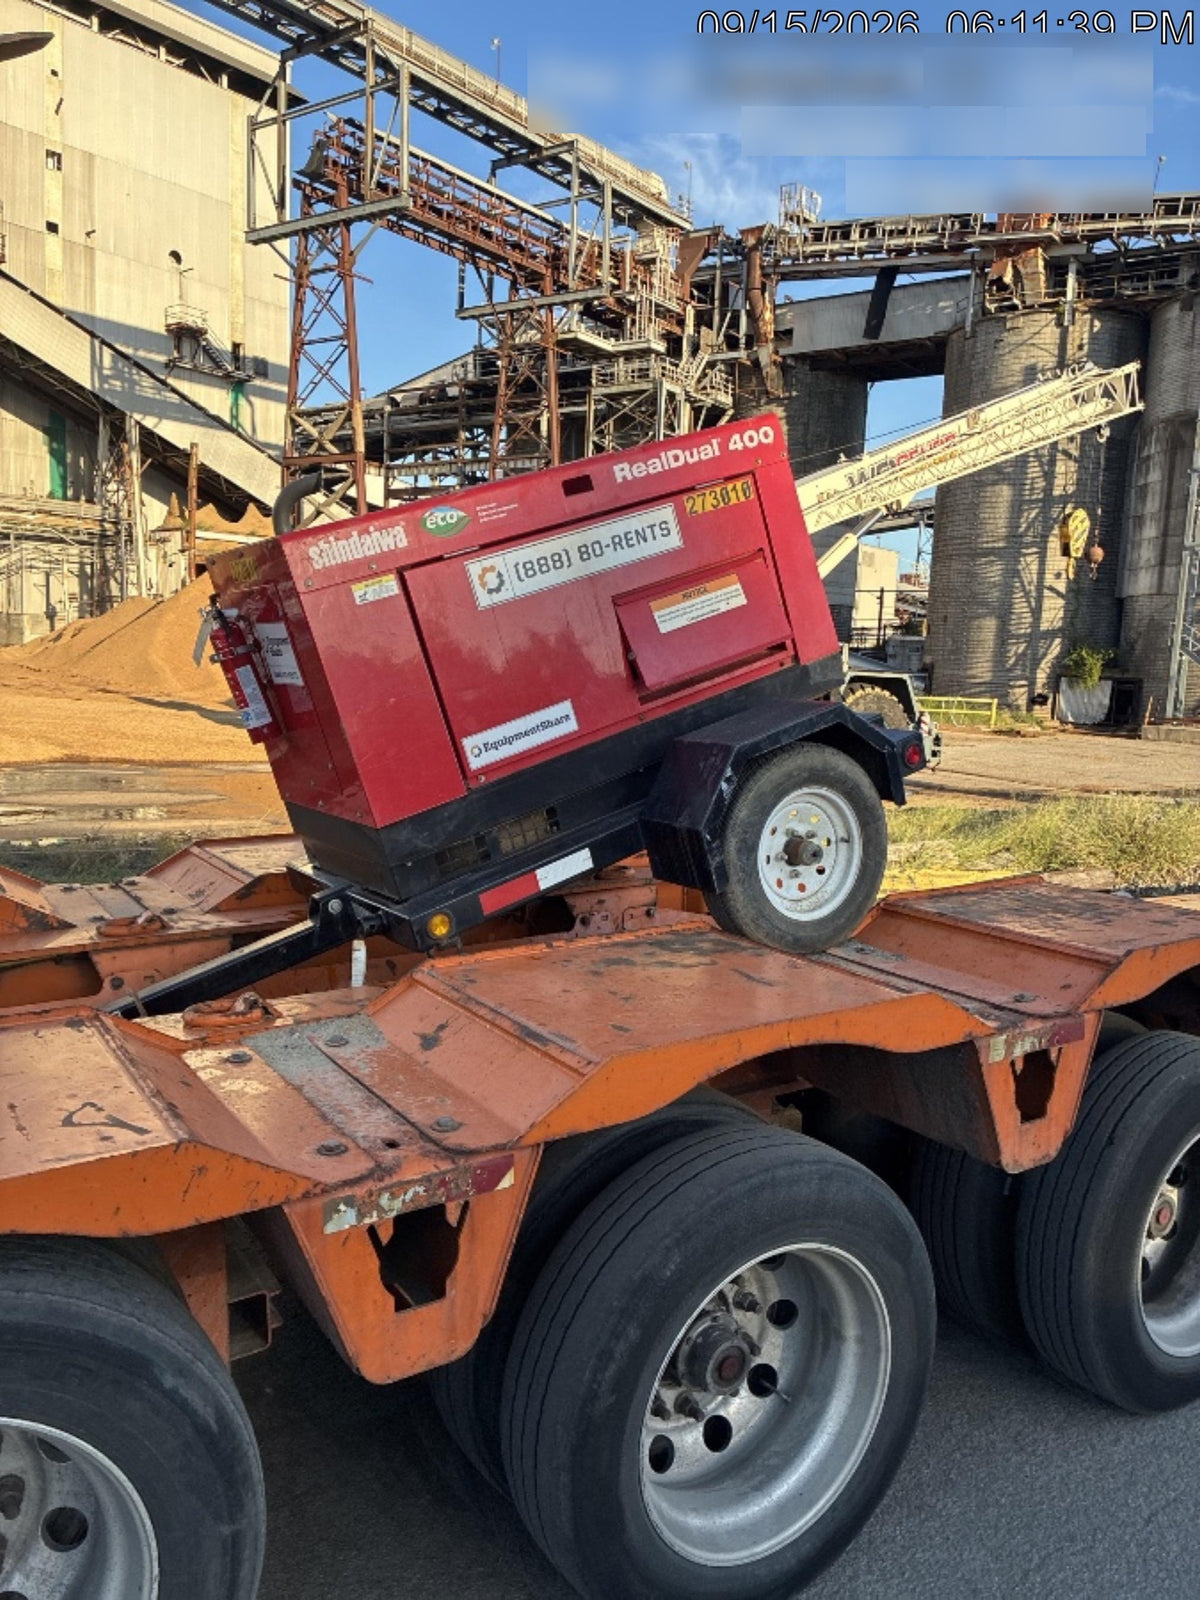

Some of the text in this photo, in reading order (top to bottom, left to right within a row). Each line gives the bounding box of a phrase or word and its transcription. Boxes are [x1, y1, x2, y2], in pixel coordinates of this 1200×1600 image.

[613, 426, 774, 483] RealDual 400
[686, 479, 752, 515] 273010
[425, 510, 459, 528] eco
[513, 520, 671, 583] (888) 80-RENTS
[482, 714, 571, 753] EquipmentShare
